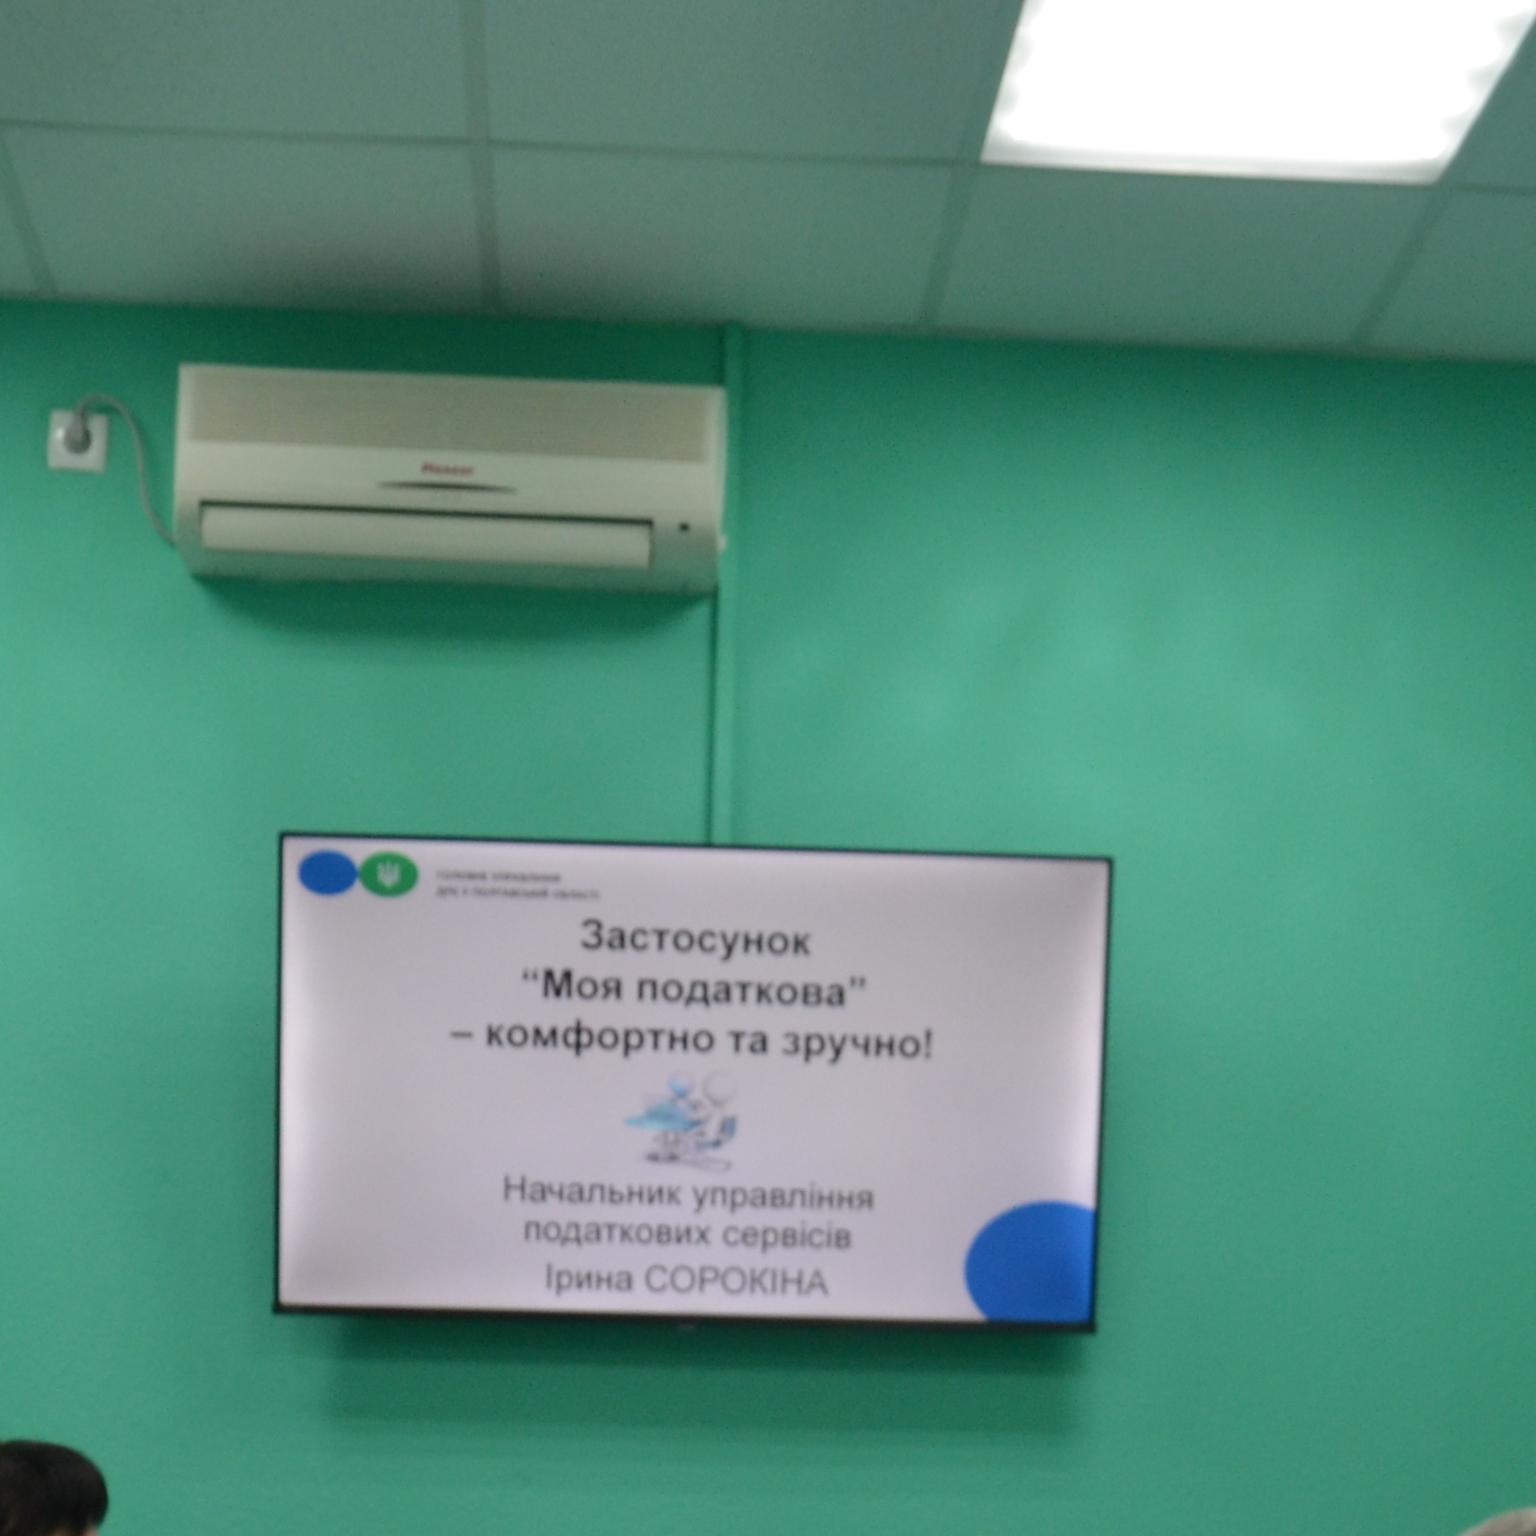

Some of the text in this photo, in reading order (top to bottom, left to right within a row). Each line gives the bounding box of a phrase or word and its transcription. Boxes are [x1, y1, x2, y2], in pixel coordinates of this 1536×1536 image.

[580, 917, 812, 961] Застосунок
[486, 1018, 715, 1057] комфортно
[727, 1030, 770, 1054] та
[782, 1028, 933, 1064] зручно!
[503, 1175, 875, 1213] Начальник управління
[523, 1218, 852, 1252] податкових сервісів
[546, 1262, 829, 1296] Ірина СОРОКІНА
